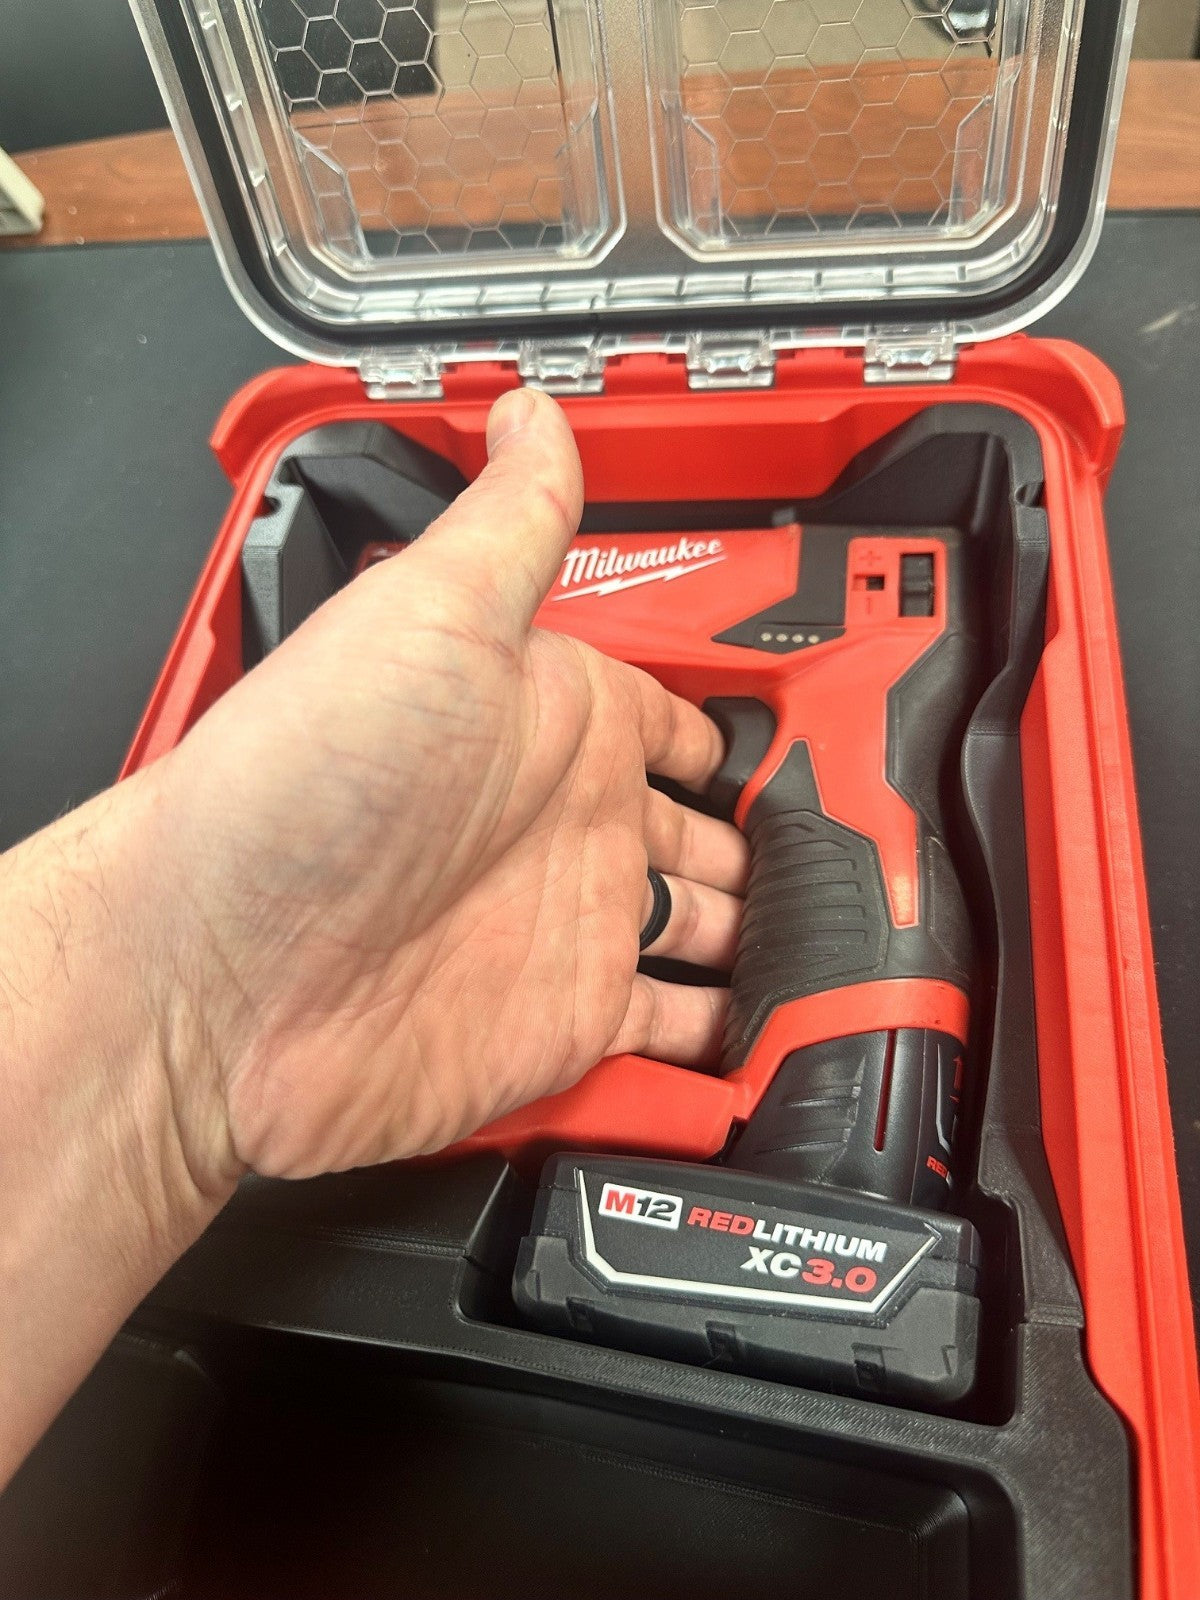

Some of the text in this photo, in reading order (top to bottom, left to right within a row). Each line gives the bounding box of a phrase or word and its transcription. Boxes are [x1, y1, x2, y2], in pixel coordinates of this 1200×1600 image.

[560, 537, 724, 587] Milwaukee
[604, 1189, 888, 1262] M12 REDLITHIUM
[740, 1246, 878, 1293] XC3.0
